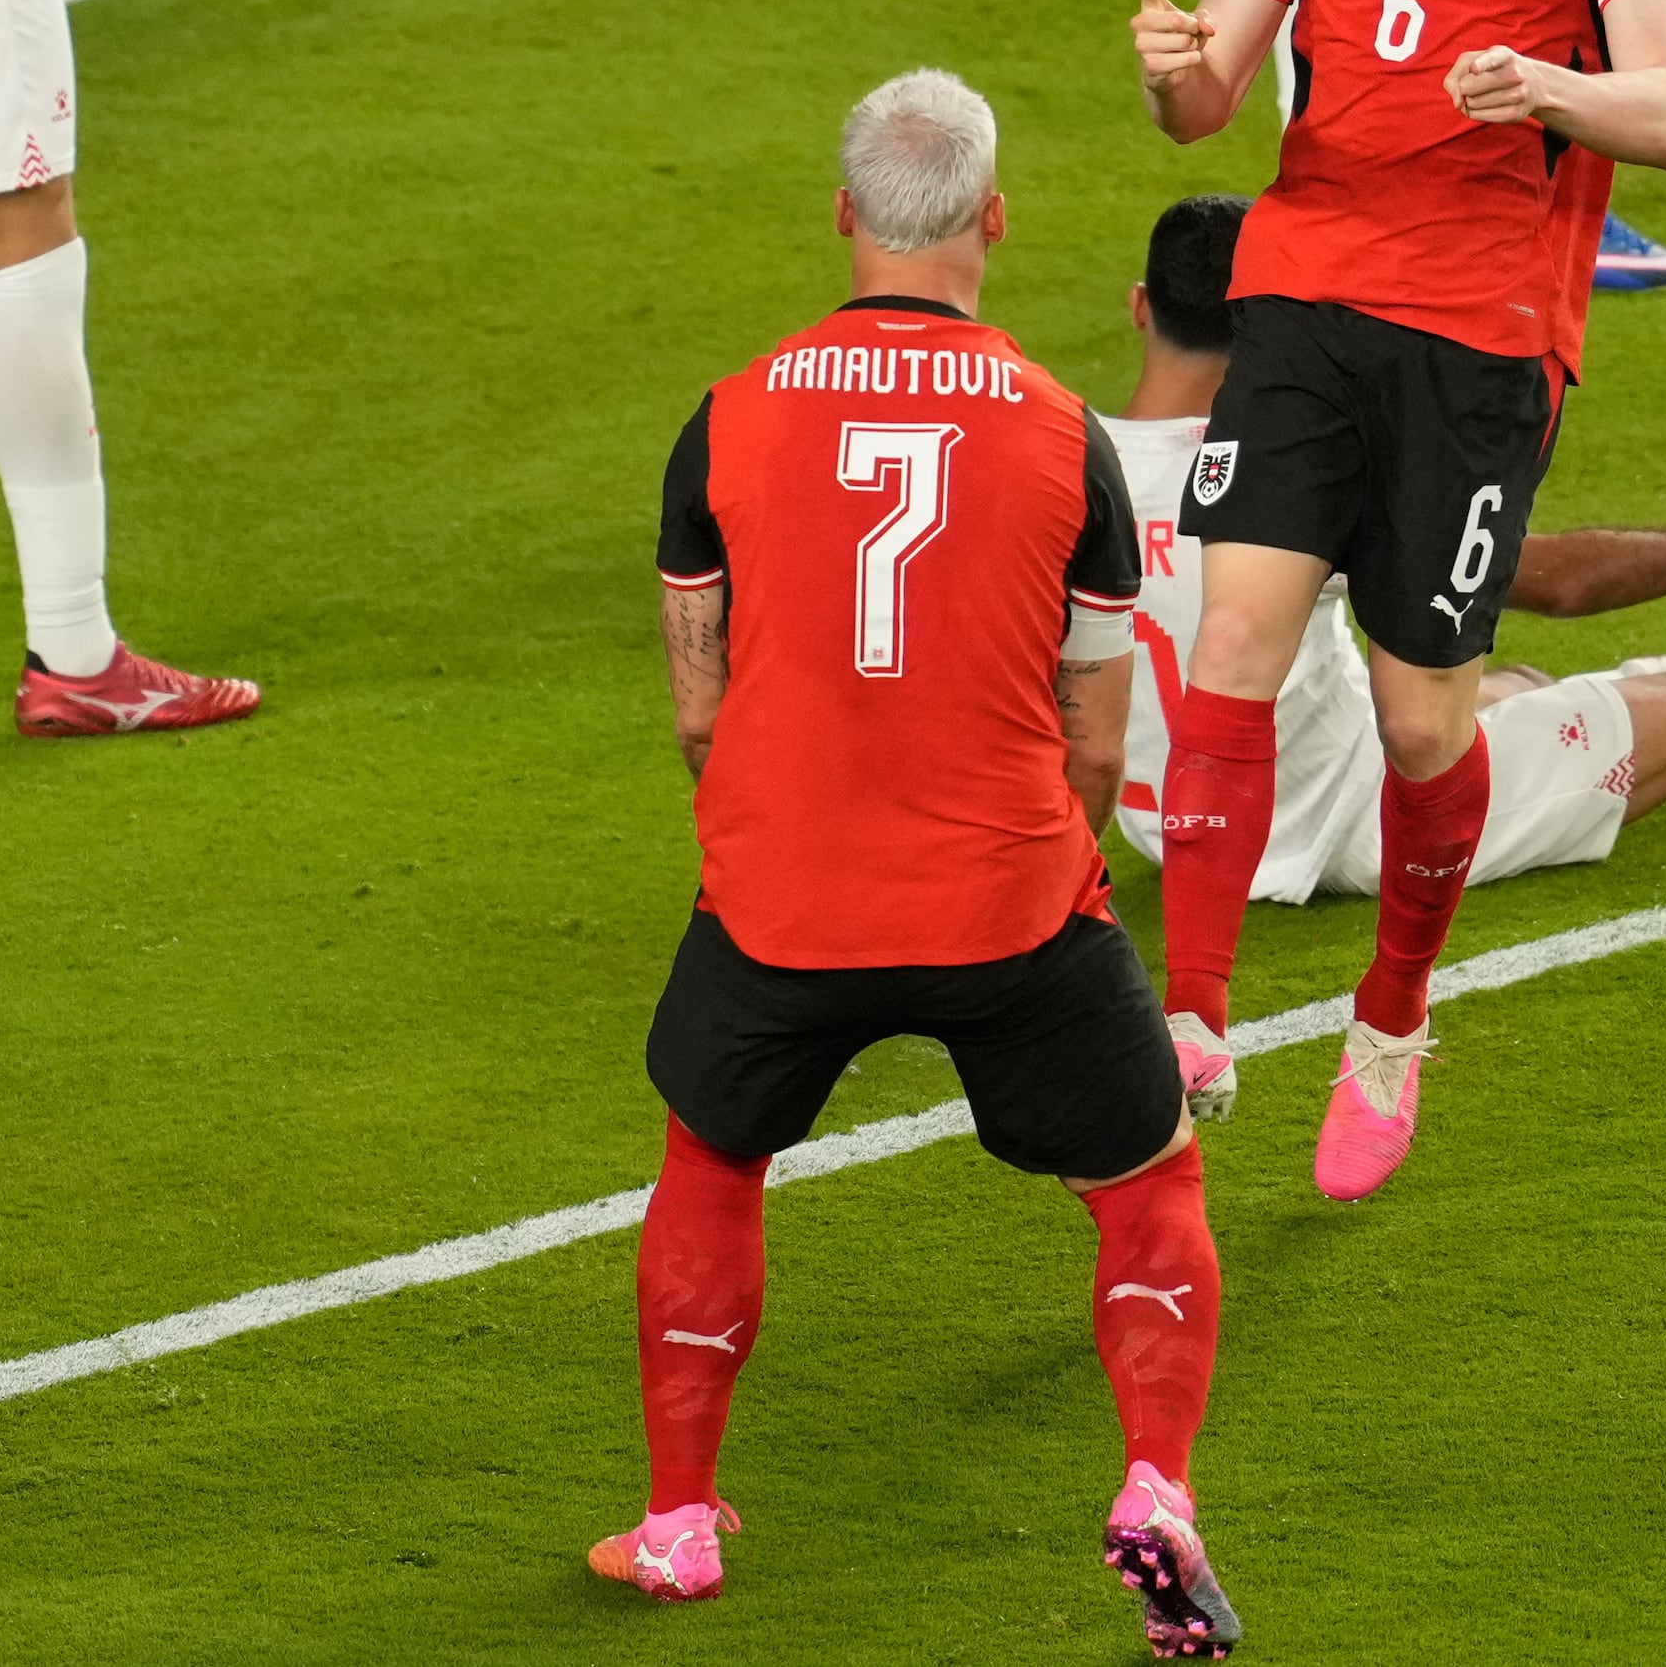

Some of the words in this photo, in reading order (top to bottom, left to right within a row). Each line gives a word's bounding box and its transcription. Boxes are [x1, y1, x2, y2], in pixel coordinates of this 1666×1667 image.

[766, 345, 1025, 404] ARNAUTOVIC
[836, 419, 966, 679] 7
[1449, 483, 1503, 594] 6
[1163, 814, 1227, 831] ÖFB
